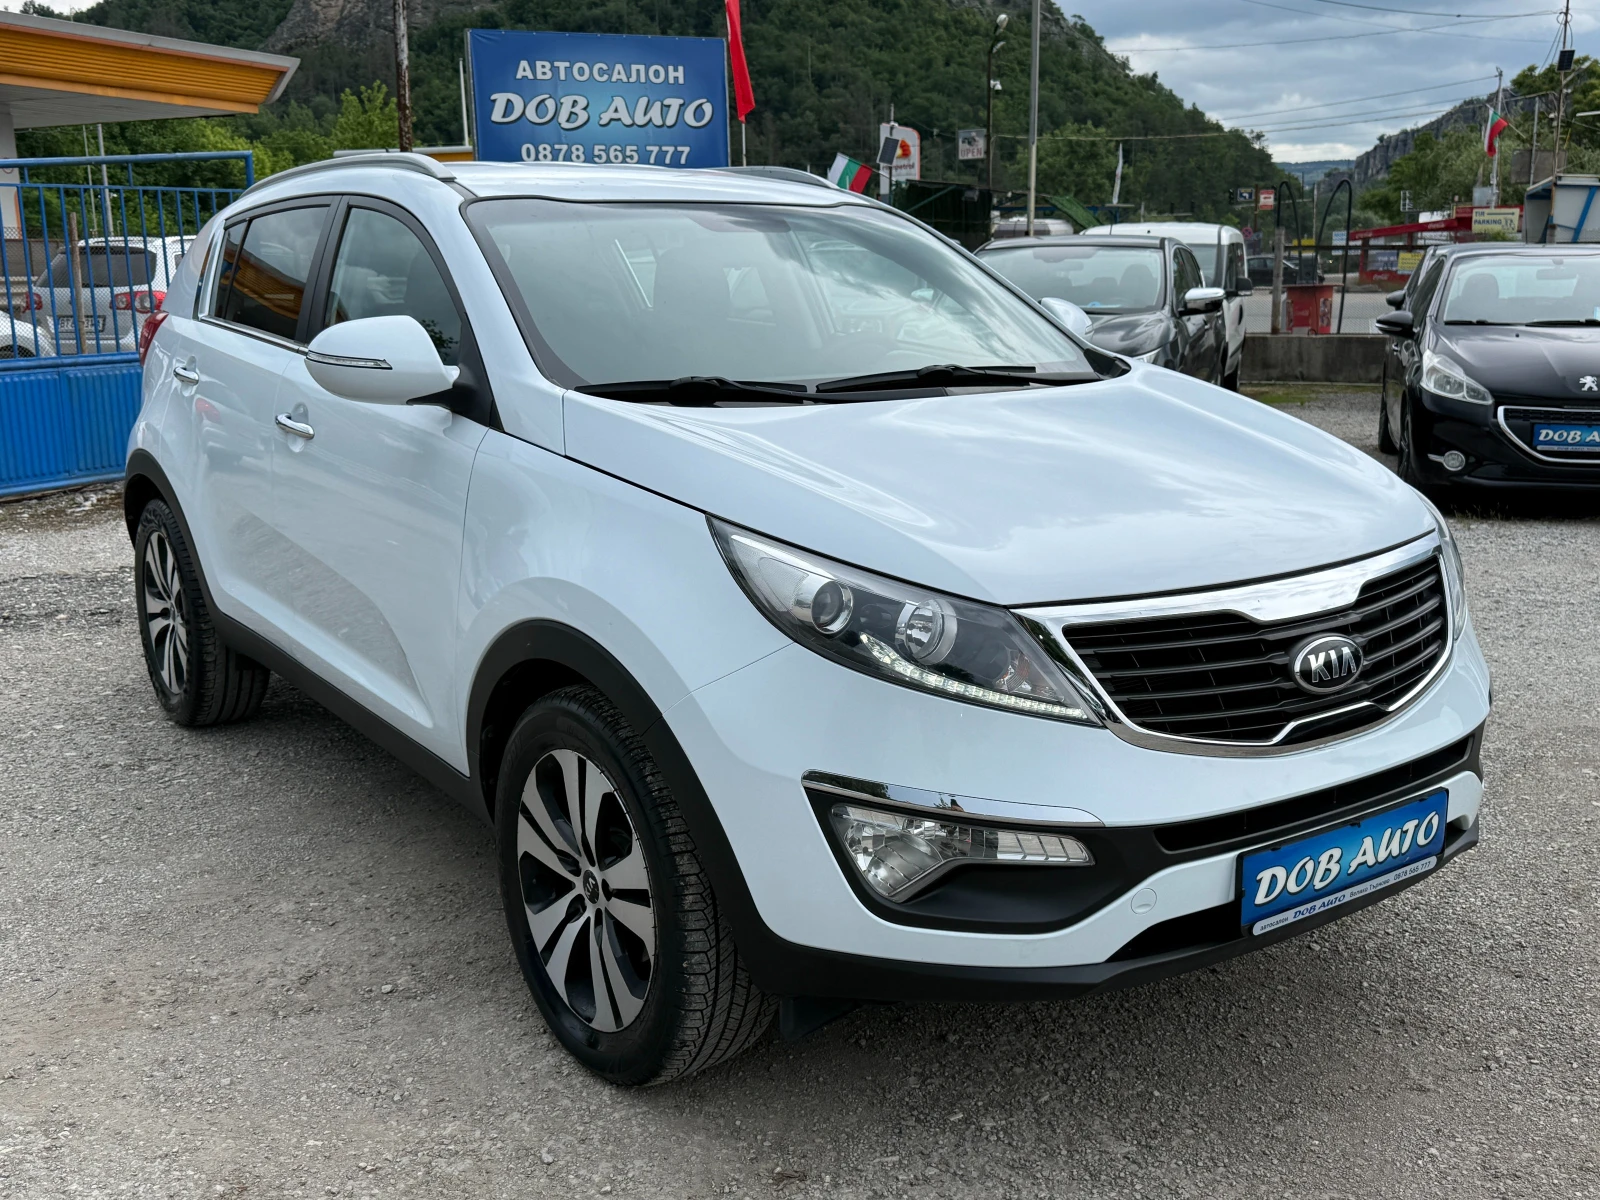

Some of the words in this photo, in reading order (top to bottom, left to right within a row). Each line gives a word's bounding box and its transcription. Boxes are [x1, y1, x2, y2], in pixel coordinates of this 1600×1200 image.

[515, 60, 685, 85] АВТОСАЛОН
[489, 92, 591, 131] DOB
[598, 96, 714, 128] AUTO
[520, 143, 586, 163] 0878
[592, 145, 639, 164] 565
[645, 146, 691, 165] 777
[960, 148, 983, 158] OPEN
[1538, 429, 1582, 444] DOB
[1307, 646, 1357, 683] KIA
[1254, 847, 1343, 905] DOB
[1347, 811, 1440, 876] AUTO
[1259, 916, 1289, 931] автосалон
[1292, 903, 1317, 919] DOB
[1318, 894, 1346, 911] AUTO
[1393, 870, 1408, 881] 0878
[1409, 865, 1419, 876] 565
[1420, 861, 1431, 871] 777
